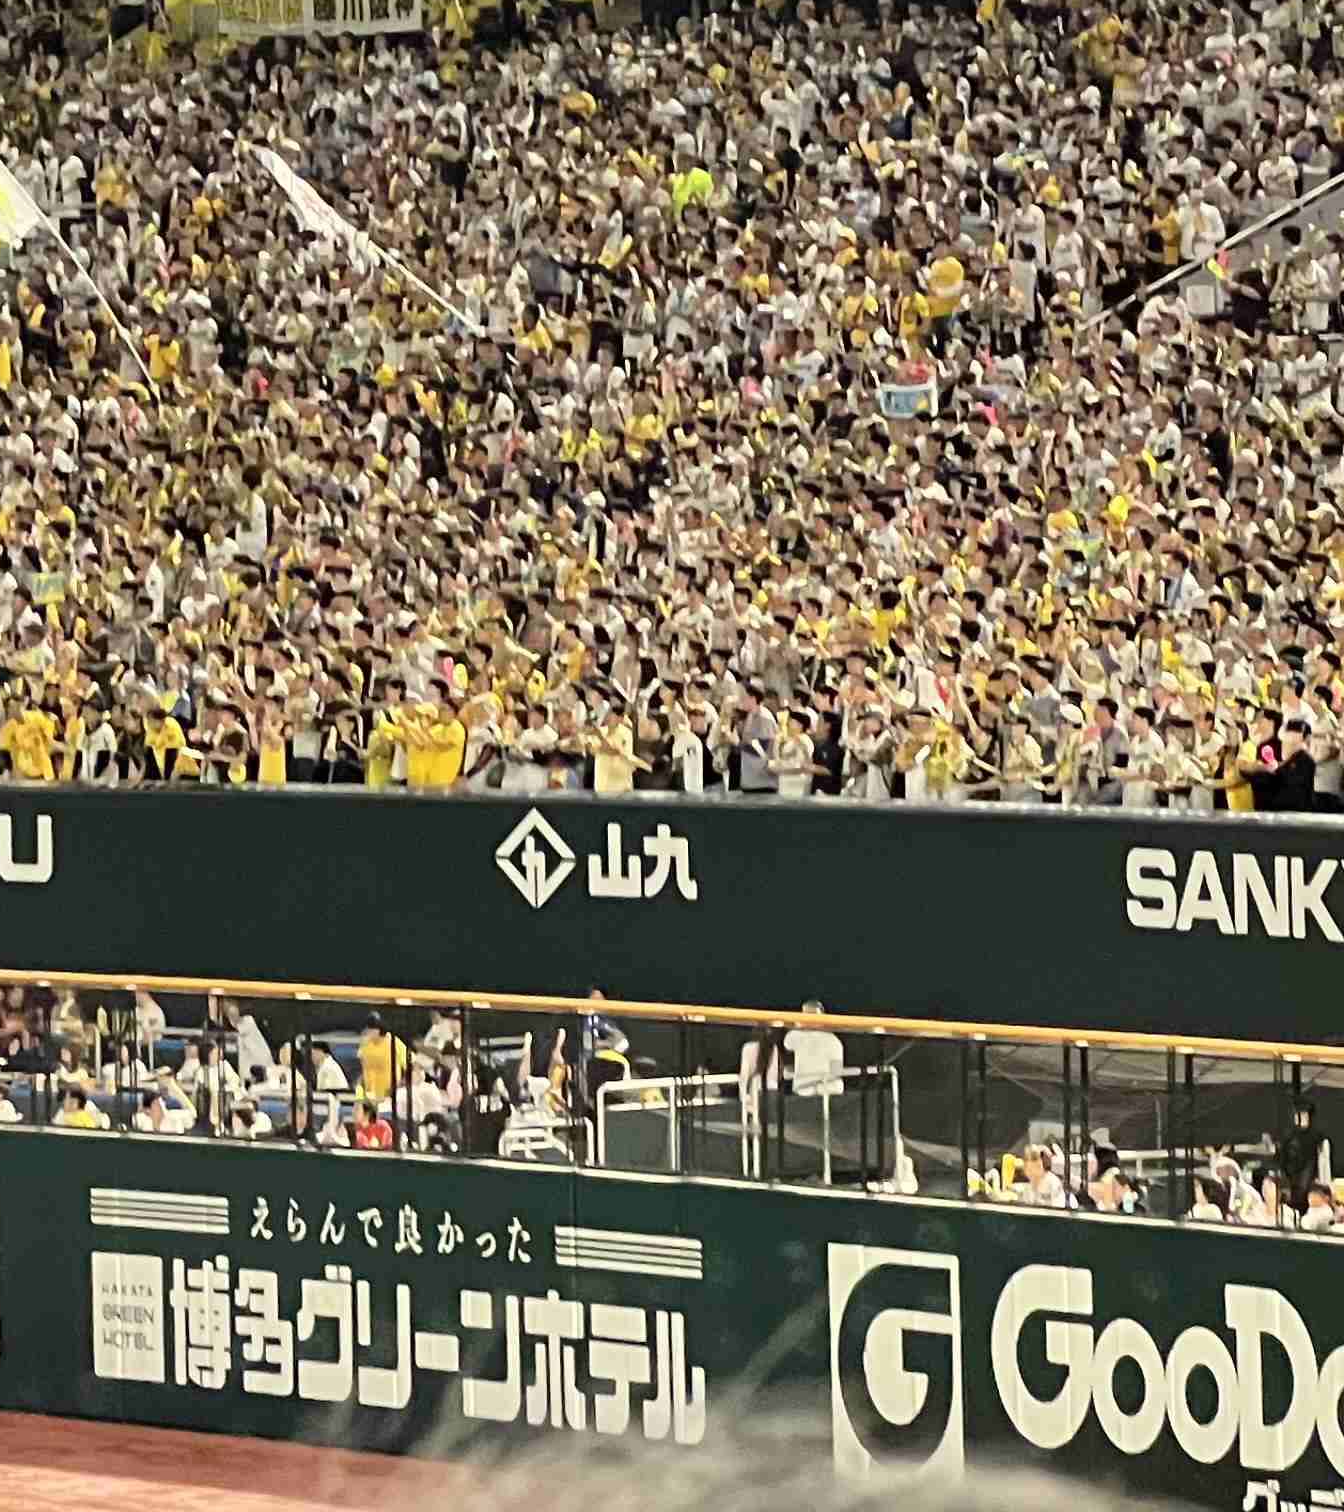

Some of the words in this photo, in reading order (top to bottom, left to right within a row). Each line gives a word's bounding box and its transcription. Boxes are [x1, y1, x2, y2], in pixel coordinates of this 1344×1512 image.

[588, 823, 697, 901] 山九
[251, 1196, 532, 1263] えらんで良かった
[170, 1254, 705, 1445] 博多グリーンホテル
